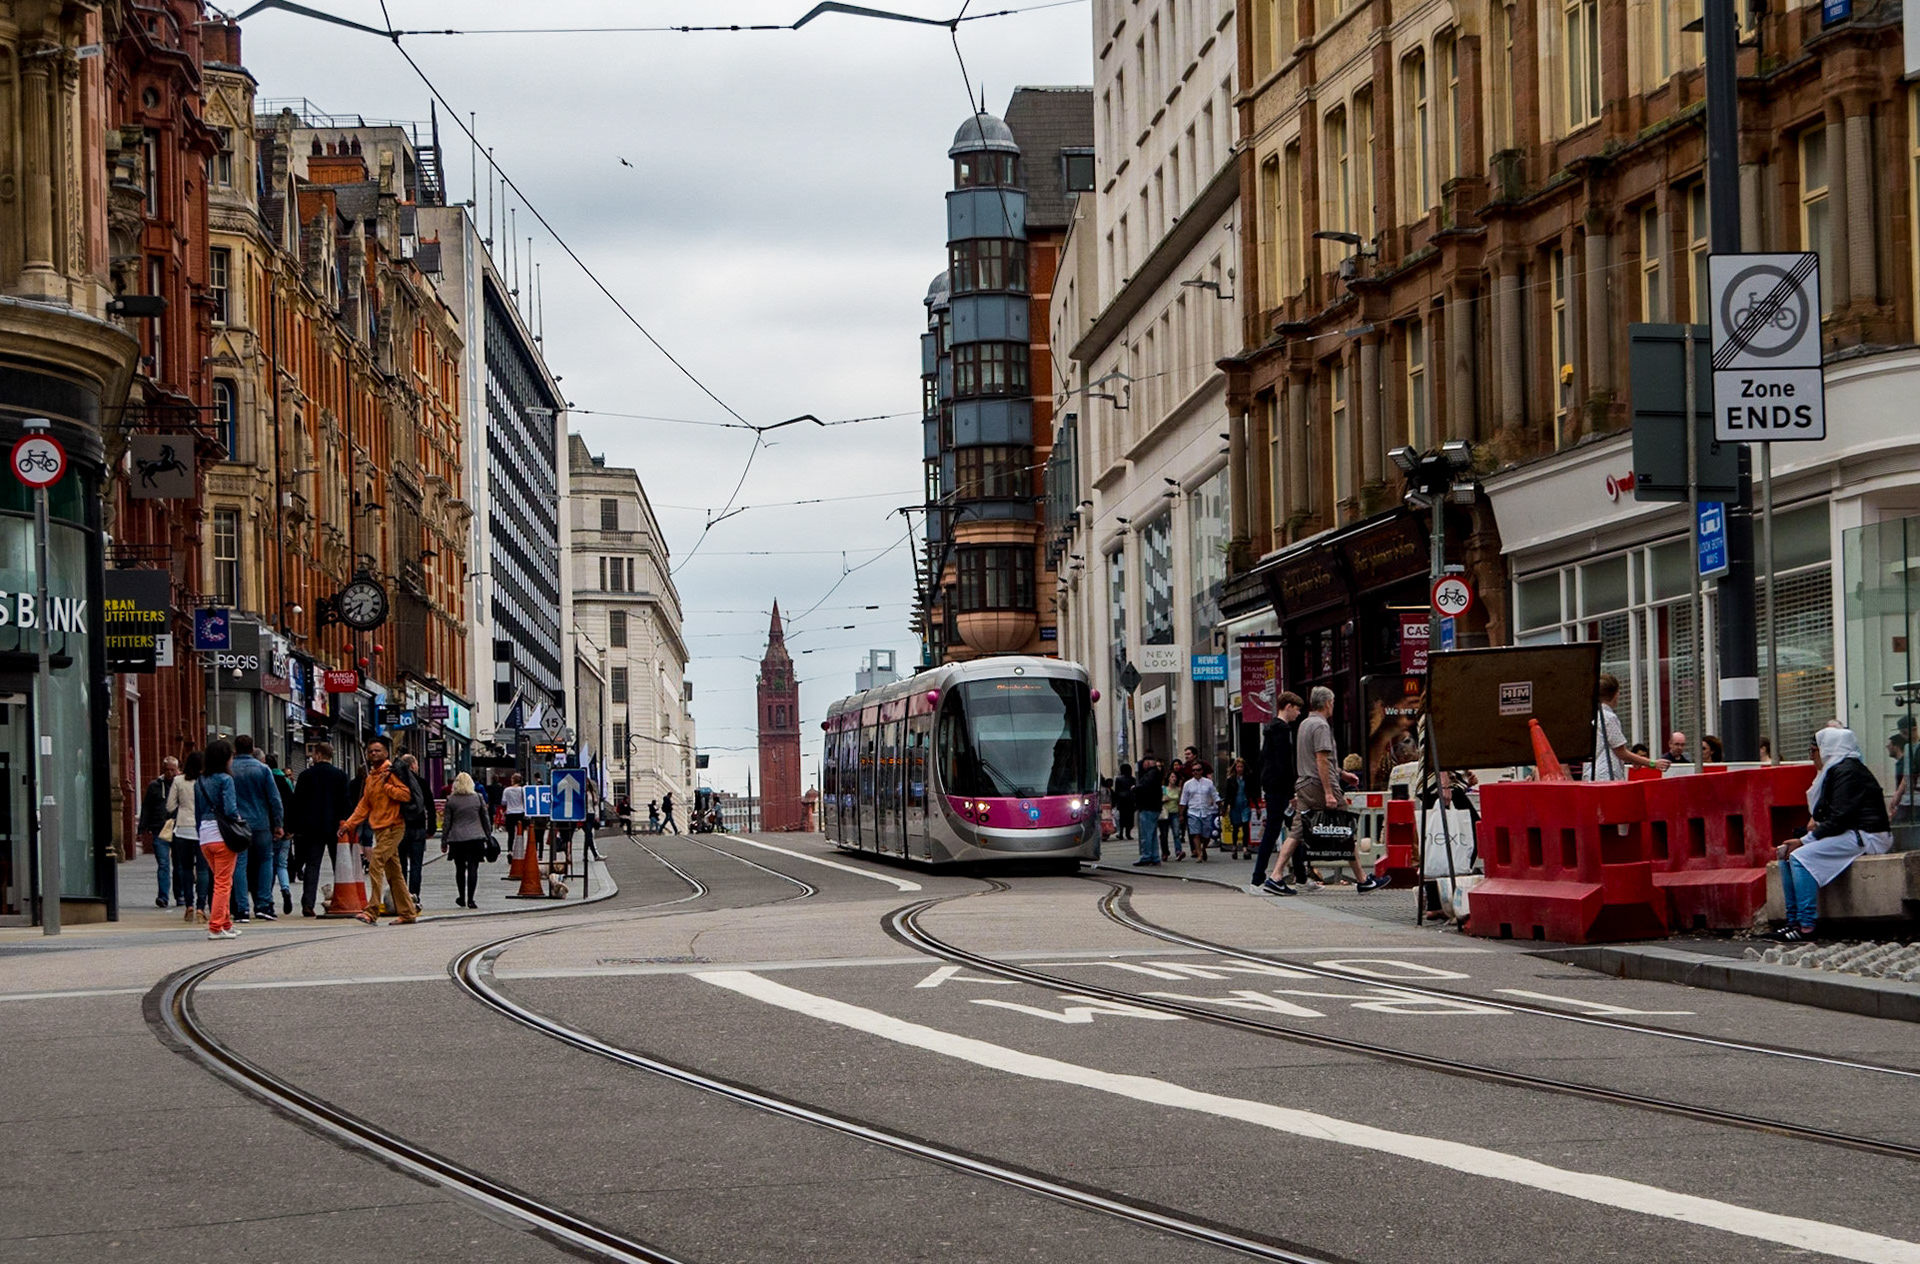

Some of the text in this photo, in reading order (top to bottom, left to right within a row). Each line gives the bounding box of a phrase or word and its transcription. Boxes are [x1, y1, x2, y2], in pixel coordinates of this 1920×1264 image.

[1740, 379, 1795, 398] Zone
[1726, 405, 1812, 430] ENDS
[1706, 552, 1718, 565] WAYS
[104, 600, 136, 611] RBAN
[17, 592, 87, 634] BANK
[104, 611, 166, 622] UTFITTERS
[1406, 626, 1430, 636] CAS
[105, 635, 155, 648] TFITTERS
[1413, 650, 1428, 658] Gol
[1143, 659, 1177, 668] LOOK
[1197, 655, 1219, 665] NEWS
[1412, 658, 1427, 666] Silv
[1193, 666, 1224, 675] EXPRESS
[1404, 667, 1428, 675] Jewel
[1502, 686, 1529, 699] HTM
[1384, 707, 1399, 716] We
[545, 718, 559, 728] 15
[1312, 823, 1353, 835] slaters
[1424, 832, 1470, 847] next
